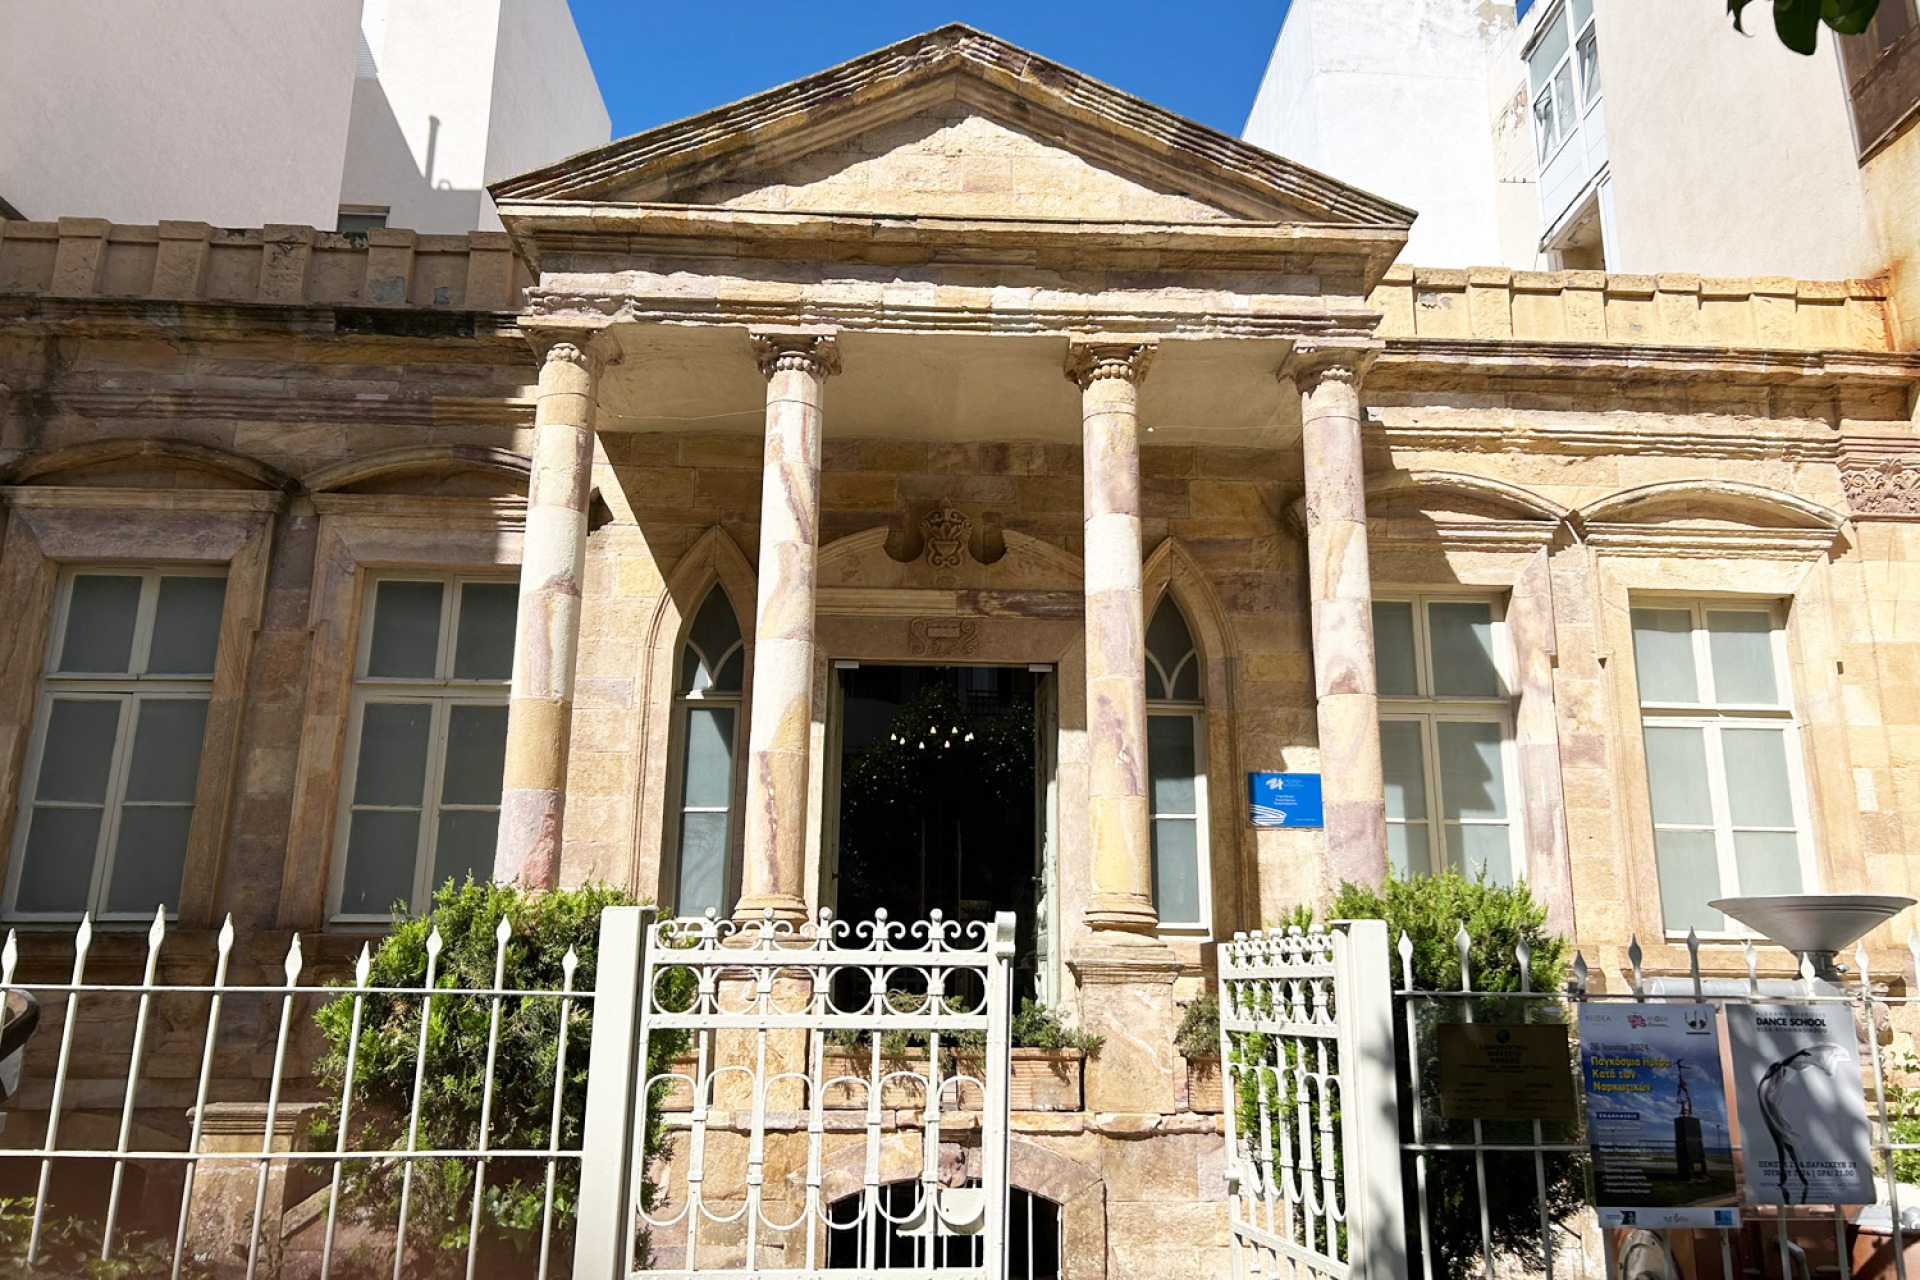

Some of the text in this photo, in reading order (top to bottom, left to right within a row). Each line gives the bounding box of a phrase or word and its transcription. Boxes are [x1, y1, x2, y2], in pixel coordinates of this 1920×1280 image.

[1756, 1017, 1826, 1027] DANCE SCHOOL
[1630, 1043, 1649, 1052] 2024
[1590, 1056, 1671, 1067] Παγκόσμια Ημέρα
[1592, 1069, 1637, 1079] Κατά των
[1593, 1081, 1652, 1092] Ναρκωτικών
